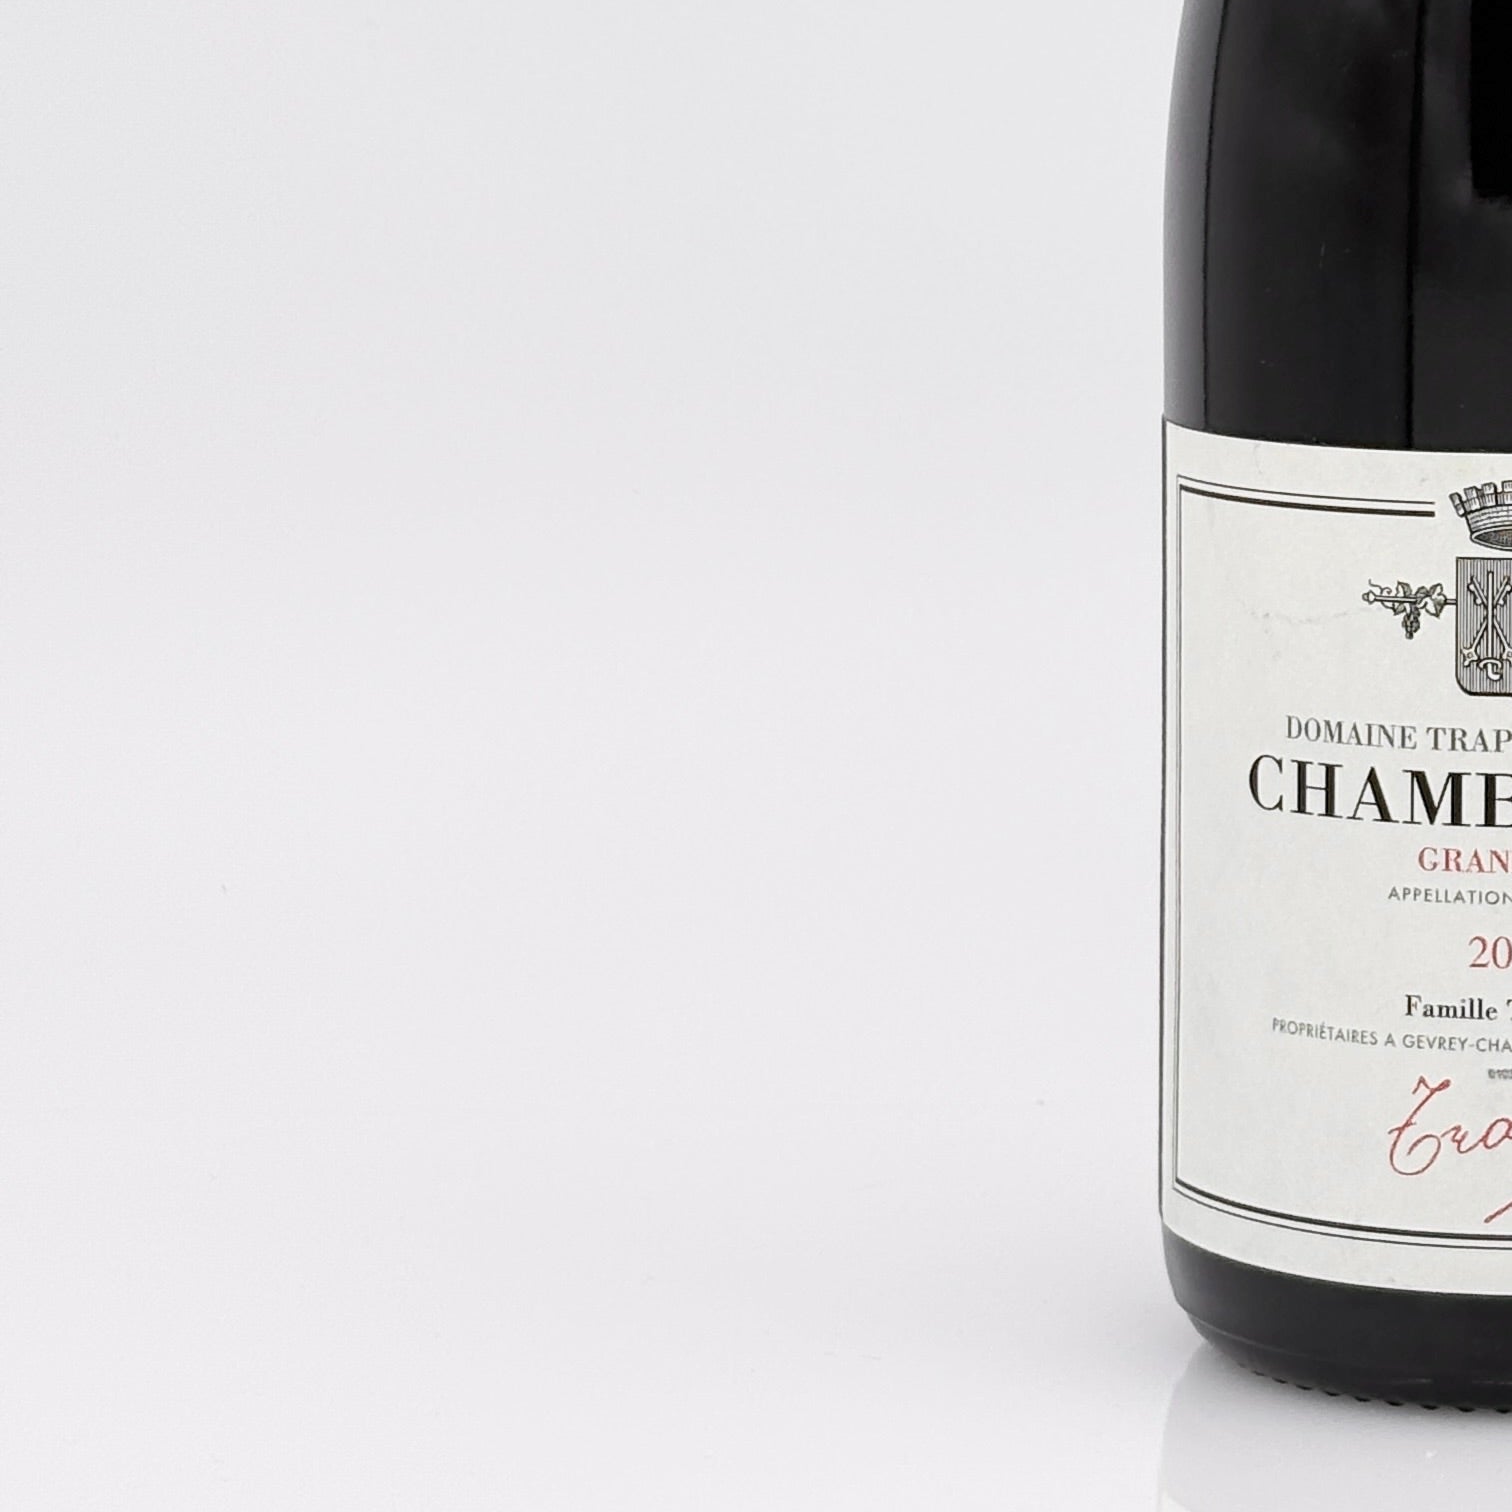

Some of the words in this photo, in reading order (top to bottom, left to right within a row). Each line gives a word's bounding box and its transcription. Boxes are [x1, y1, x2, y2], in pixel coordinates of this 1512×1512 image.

[1286, 715, 1418, 751] DOMAINE
[1404, 993, 1498, 1022] Famille
[1272, 1017, 1379, 1046] PROPRIÉTAIRES
[1384, 1032, 1396, 1047] A
